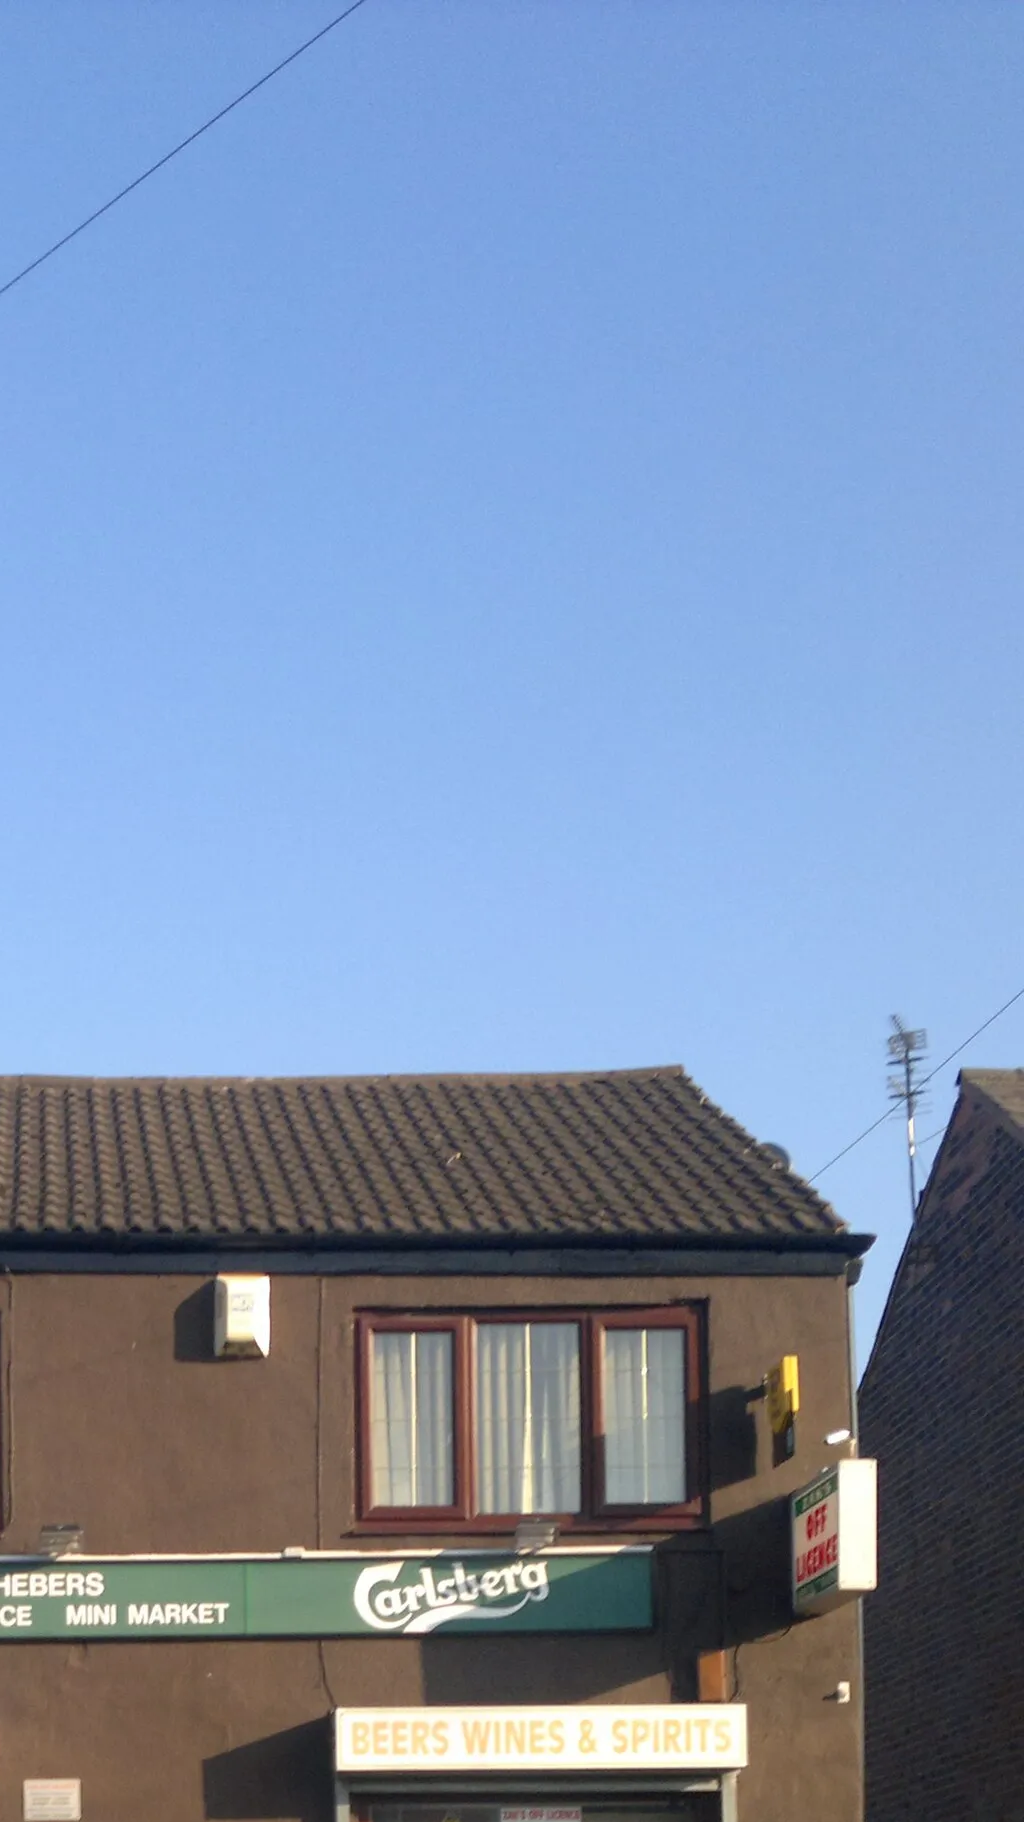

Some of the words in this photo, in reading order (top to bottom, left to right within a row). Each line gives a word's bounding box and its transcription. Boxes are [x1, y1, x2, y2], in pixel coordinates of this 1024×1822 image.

[806, 1503, 827, 1541] OFF
[65, 1603, 117, 1627] MINI
[128, 1602, 230, 1625] MARKET
[353, 1560, 550, 1633] Carlsberg
[351, 1720, 449, 1756] BEERS
[462, 1720, 565, 1755] WINES
[577, 1719, 598, 1755] &
[612, 1719, 732, 1754] SPIRITS
